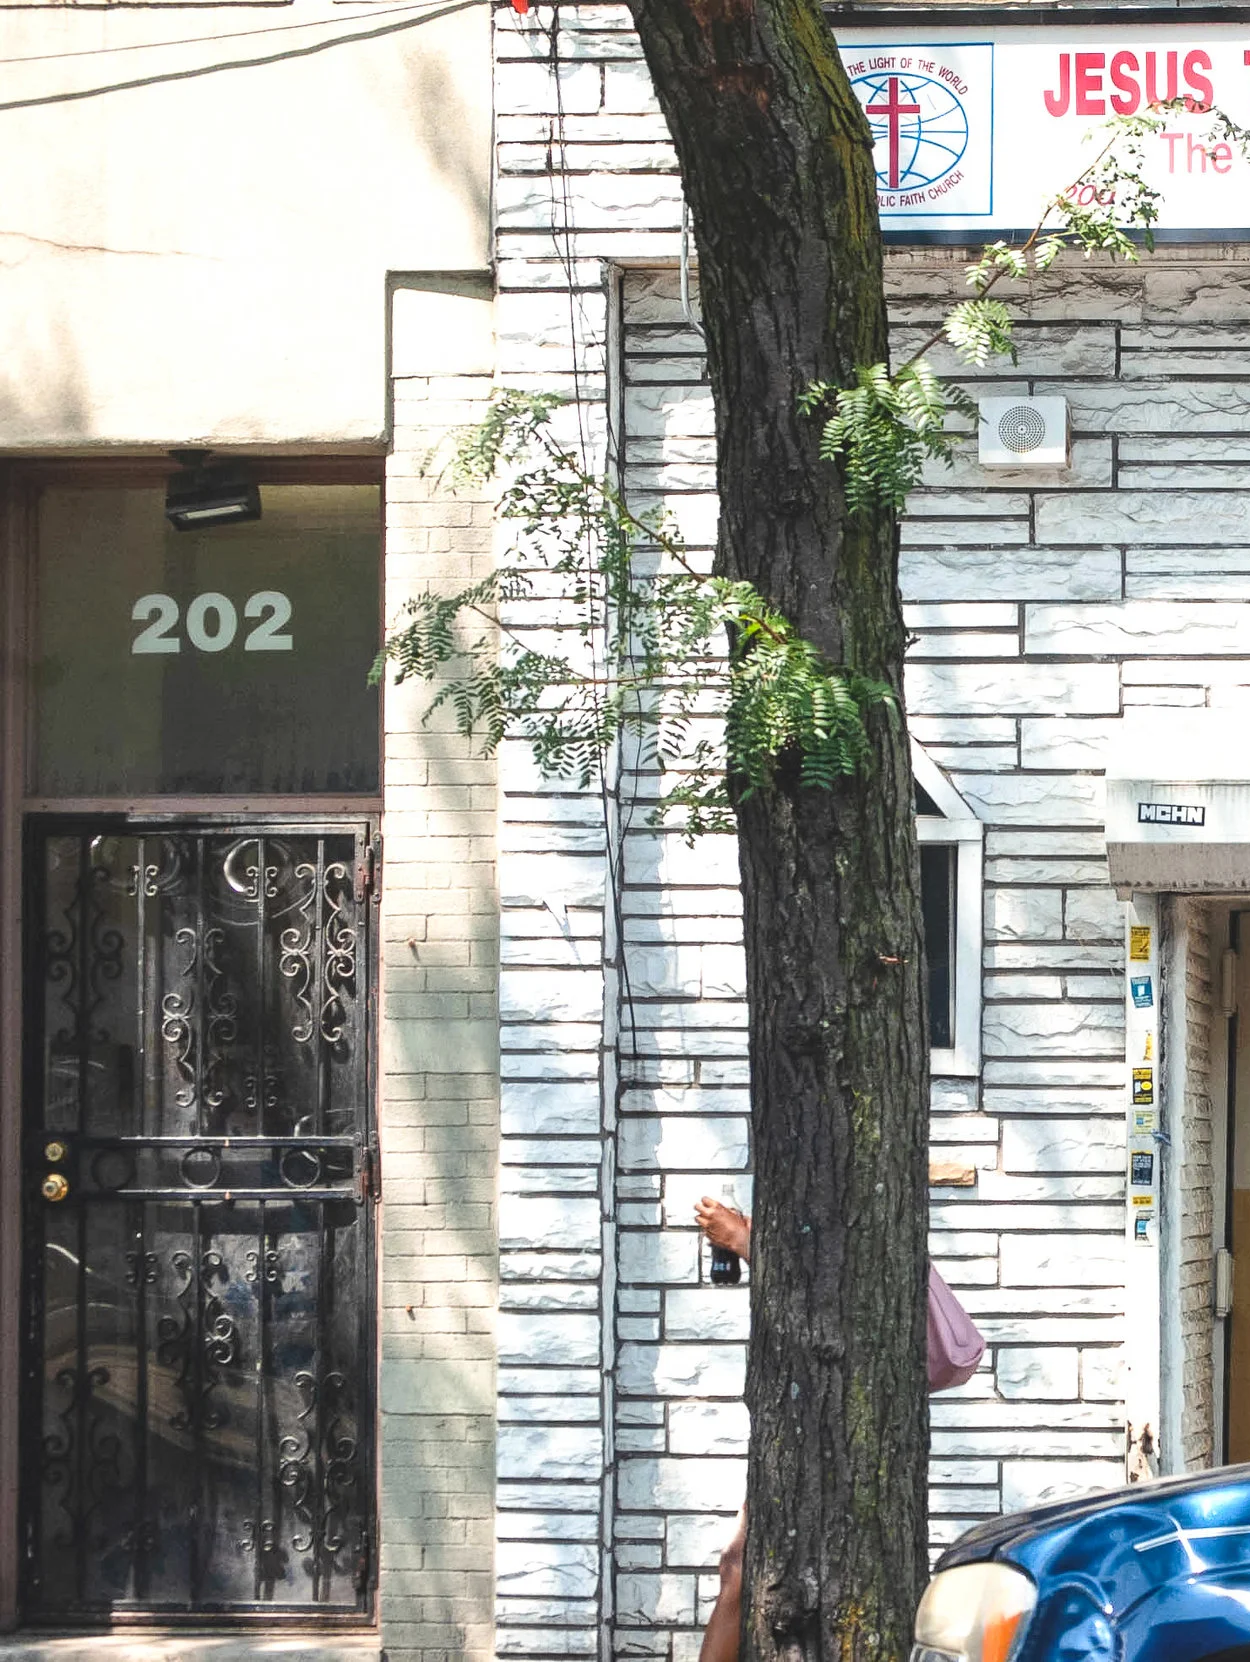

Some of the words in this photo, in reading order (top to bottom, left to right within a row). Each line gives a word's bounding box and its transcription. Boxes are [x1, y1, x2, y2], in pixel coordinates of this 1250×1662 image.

[847, 61, 866, 76] THE
[869, 57, 896, 69] LIGHT
[900, 58, 912, 68] OF
[918, 59, 936, 73] THE
[938, 66, 969, 95] WORLD
[1043, 50, 1214, 116] JESUS
[1160, 132, 1233, 174] The
[899, 191, 926, 207] FAITH
[927, 169, 965, 200] CHURCH
[132, 590, 293, 654] 202
[1139, 804, 1204, 824] MCHN
